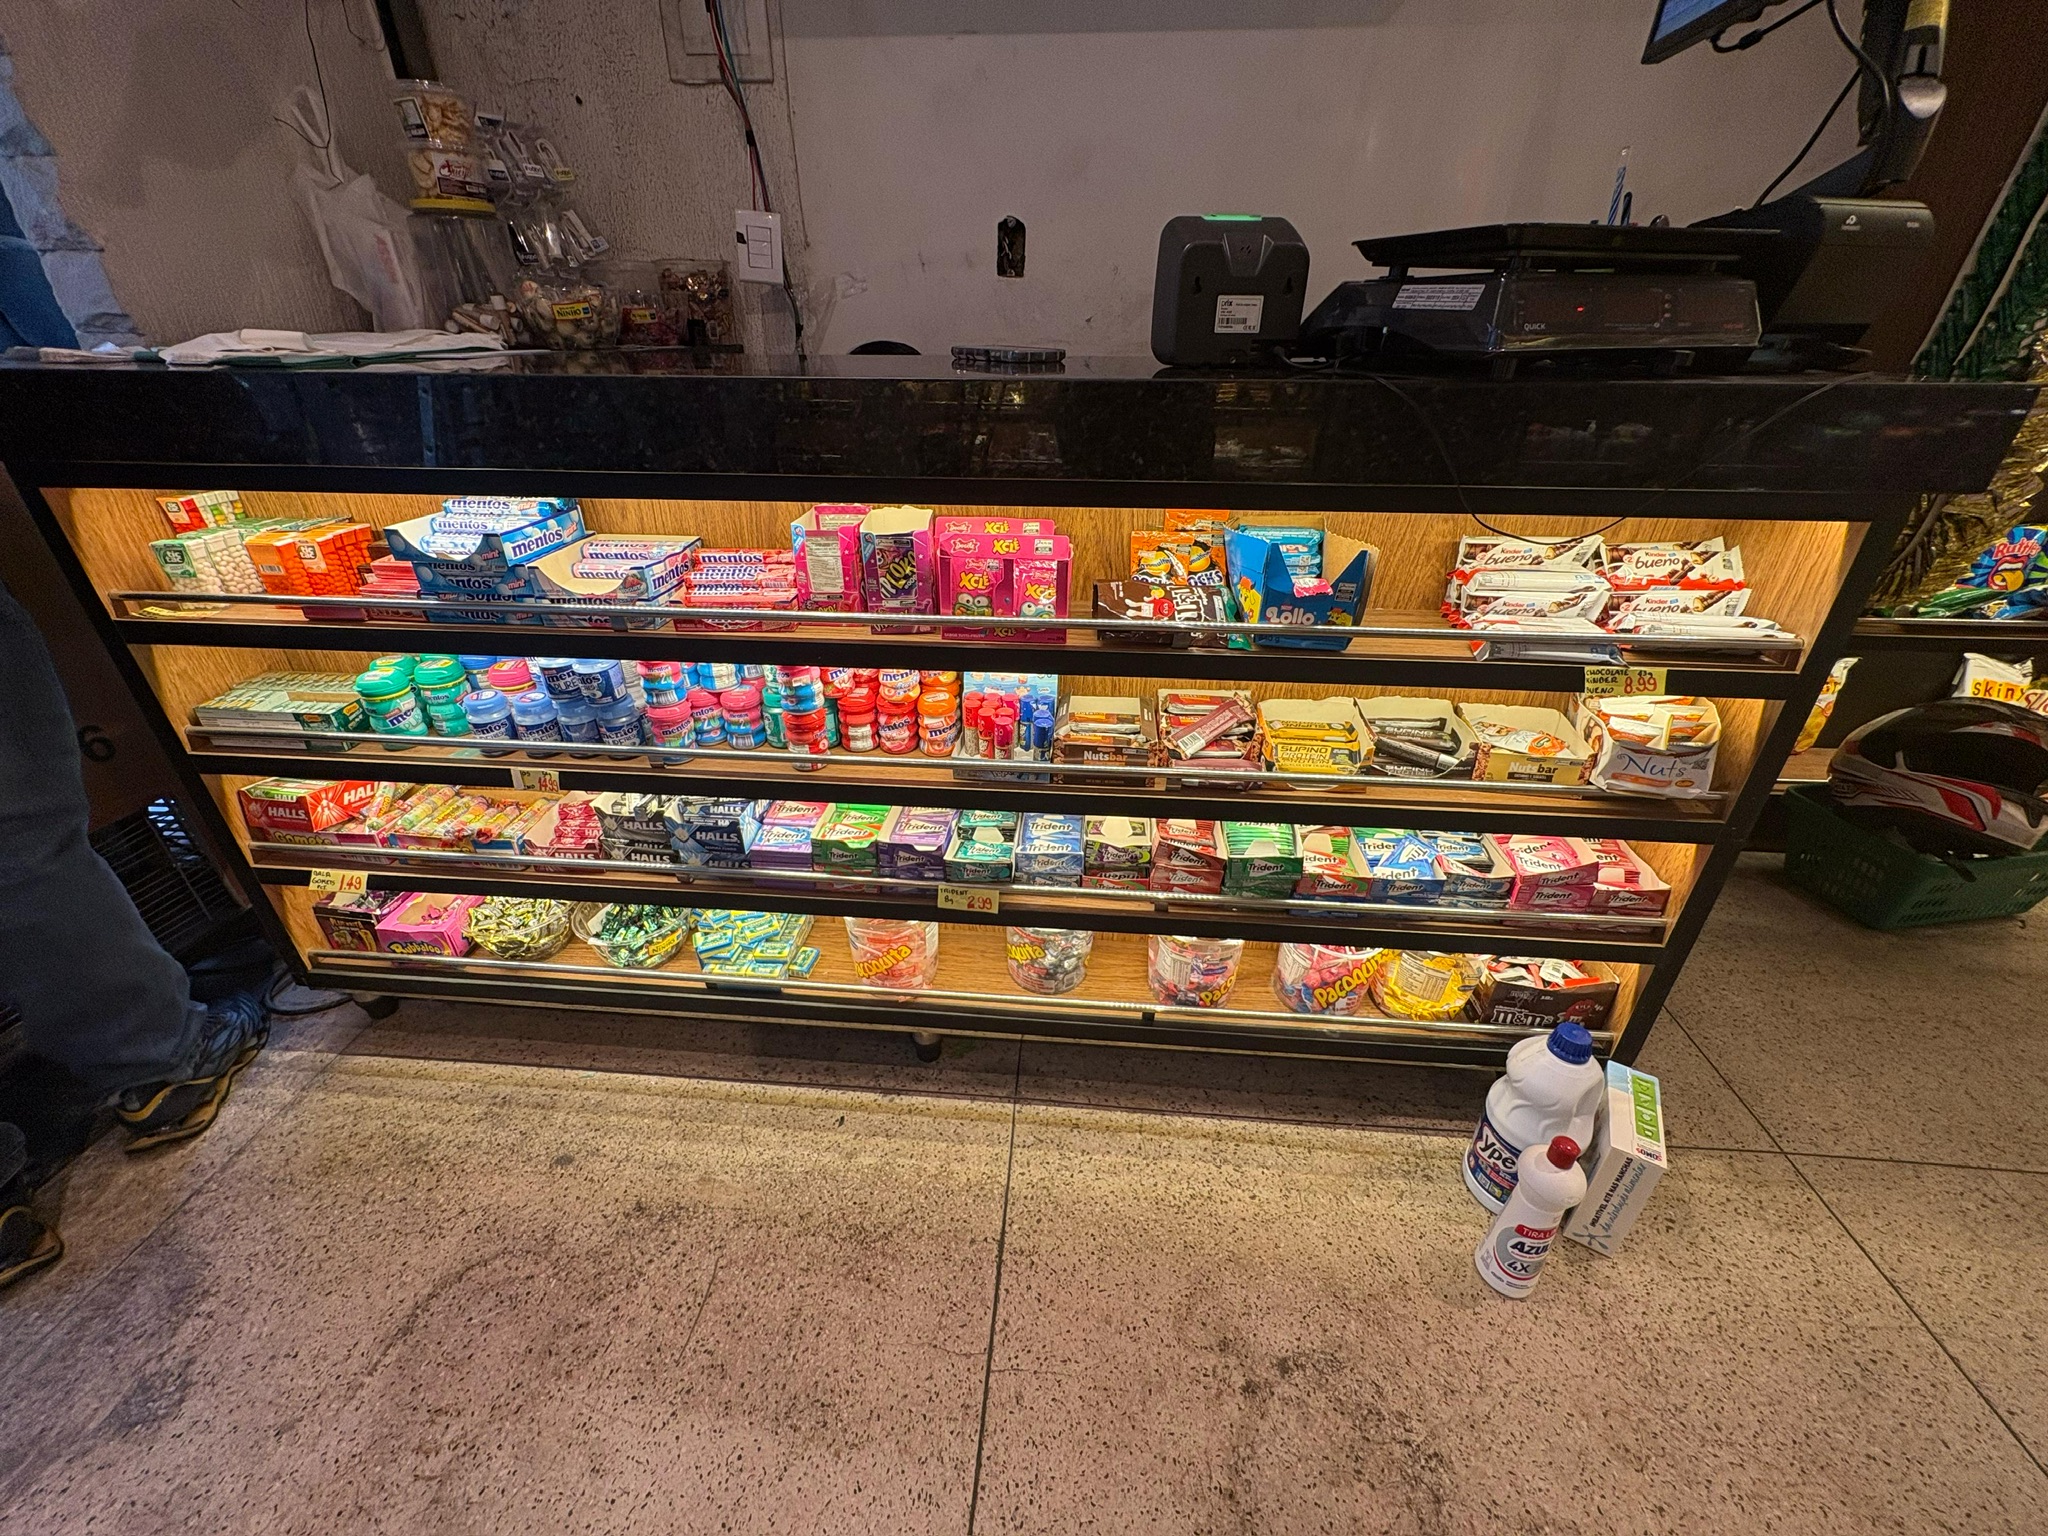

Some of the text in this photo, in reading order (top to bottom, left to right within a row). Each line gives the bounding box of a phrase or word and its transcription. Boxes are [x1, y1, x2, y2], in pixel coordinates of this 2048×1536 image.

[1523, 322, 1546, 331] QUICK
[451, 499, 511, 510] mentos
[438, 519, 488, 530] mentos
[511, 528, 563, 557] mentos
[588, 551, 648, 560] mentos
[701, 554, 763, 563] mentos
[1485, 553, 1533, 566] bueno
[1635, 555, 1680, 569] bueno
[652, 561, 689, 590] mentos
[1187, 570, 1223, 586] OCKS
[507, 579, 526, 590] mint
[1586, 668, 1629, 676] CHOCOLATE
[1586, 686, 1614, 694] BUENO
[1623, 677, 1658, 695] 8.99
[692, 707, 714, 718] entos
[475, 720, 508, 736] entos
[1083, 751, 1128, 762] Nutsbar
[1508, 762, 1558, 775] Nutsbar
[1617, 754, 1688, 778] Nuts
[268, 806, 306, 819] HALLS
[709, 805, 742, 815] HALLS
[777, 804, 816, 815] Trident
[843, 813, 878, 822] Trident
[623, 821, 664, 831] HALLS
[903, 823, 943, 832] Trident
[1030, 822, 1072, 831] Trident
[696, 831, 738, 843] HALLS
[827, 828, 868, 837] Trident
[631, 852, 670, 863] HALLS
[829, 852, 858, 861] Trident
[894, 855, 925, 863] Trident
[1172, 851, 1206, 865] Trident
[1247, 863, 1284, 872] Trident
[339, 874, 362, 891] 1.49
[1540, 872, 1580, 885] Trident
[1315, 879, 1352, 890] Trident
[1387, 883, 1424, 892] Trident
[1535, 891, 1573, 901] Trident
[1609, 894, 1648, 904] Trident
[967, 896, 993, 910] 2.99
[855, 945, 912, 978] açoquita
[1523, 1227, 1545, 1238] TIRA
